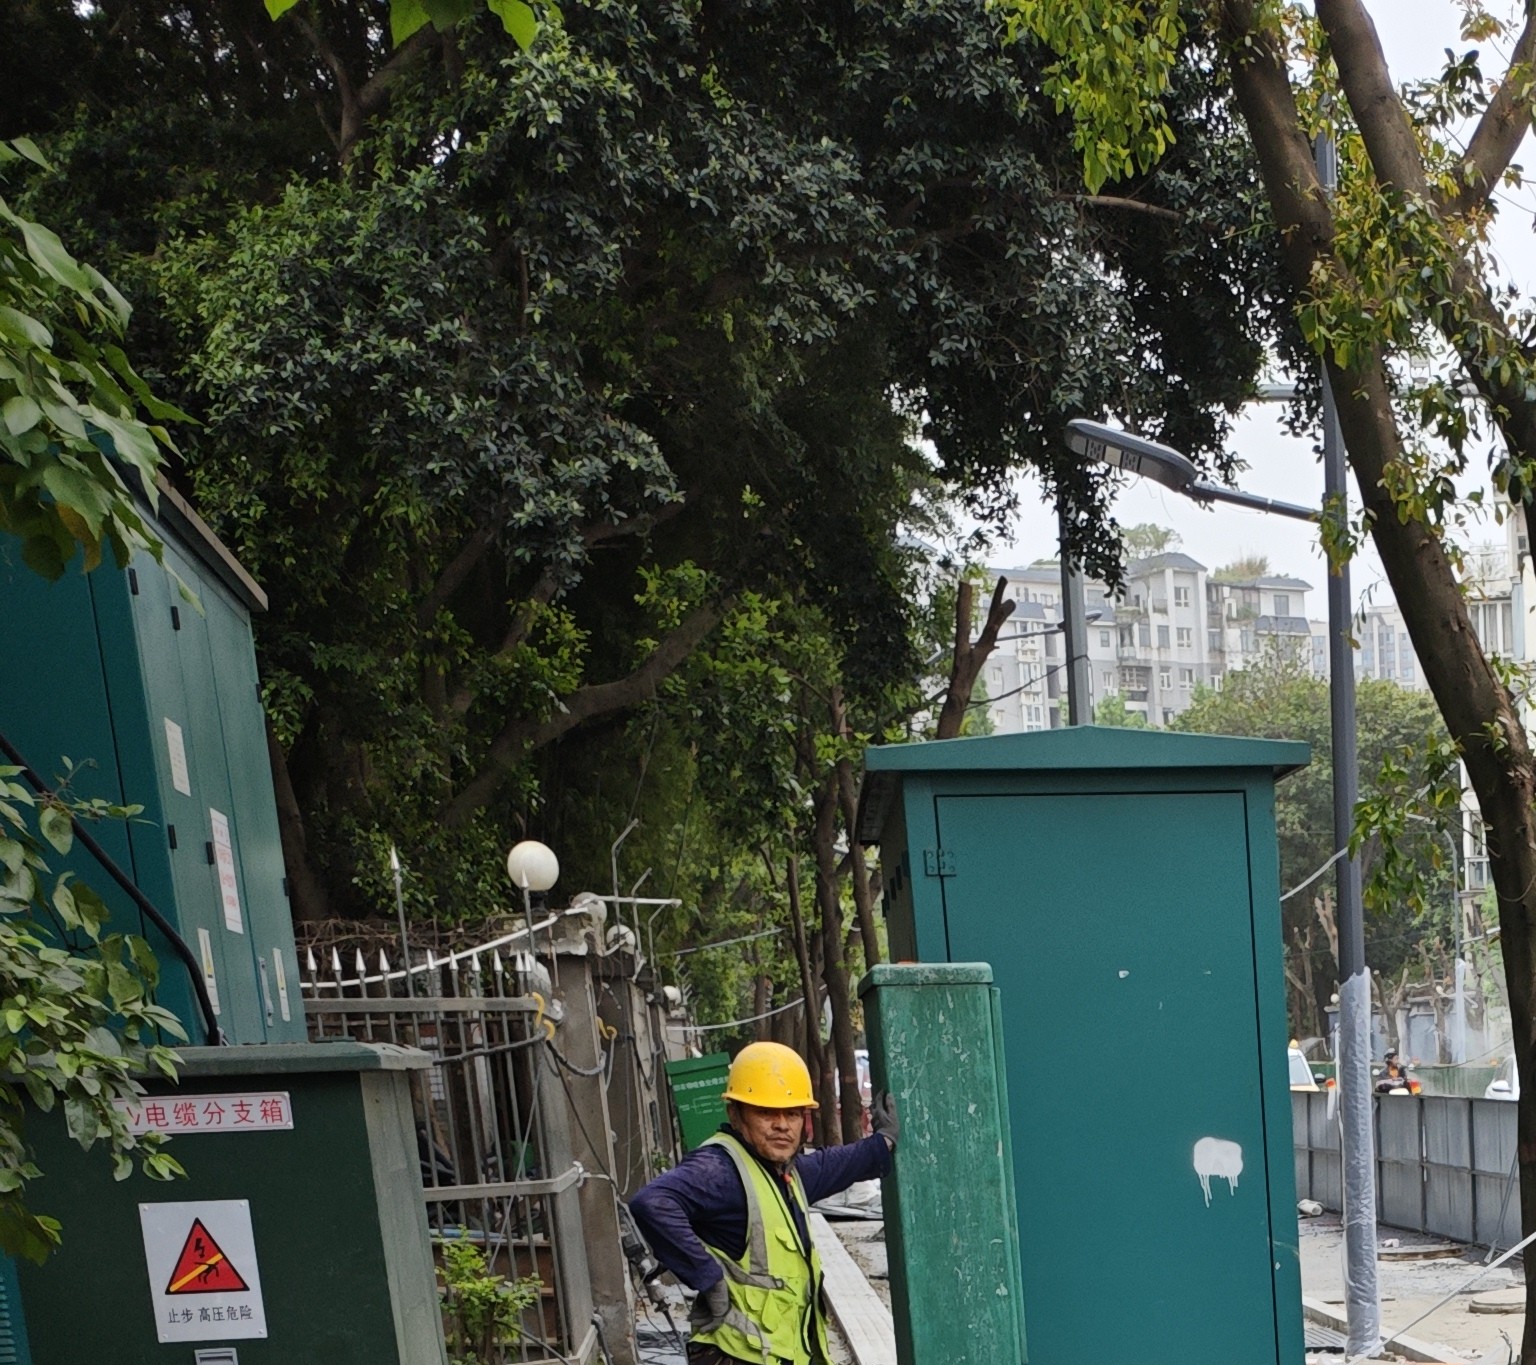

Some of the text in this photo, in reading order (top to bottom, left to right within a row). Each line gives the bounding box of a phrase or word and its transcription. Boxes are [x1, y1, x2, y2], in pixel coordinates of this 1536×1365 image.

[168, 1304, 254, 1324] 止步 高压危险
